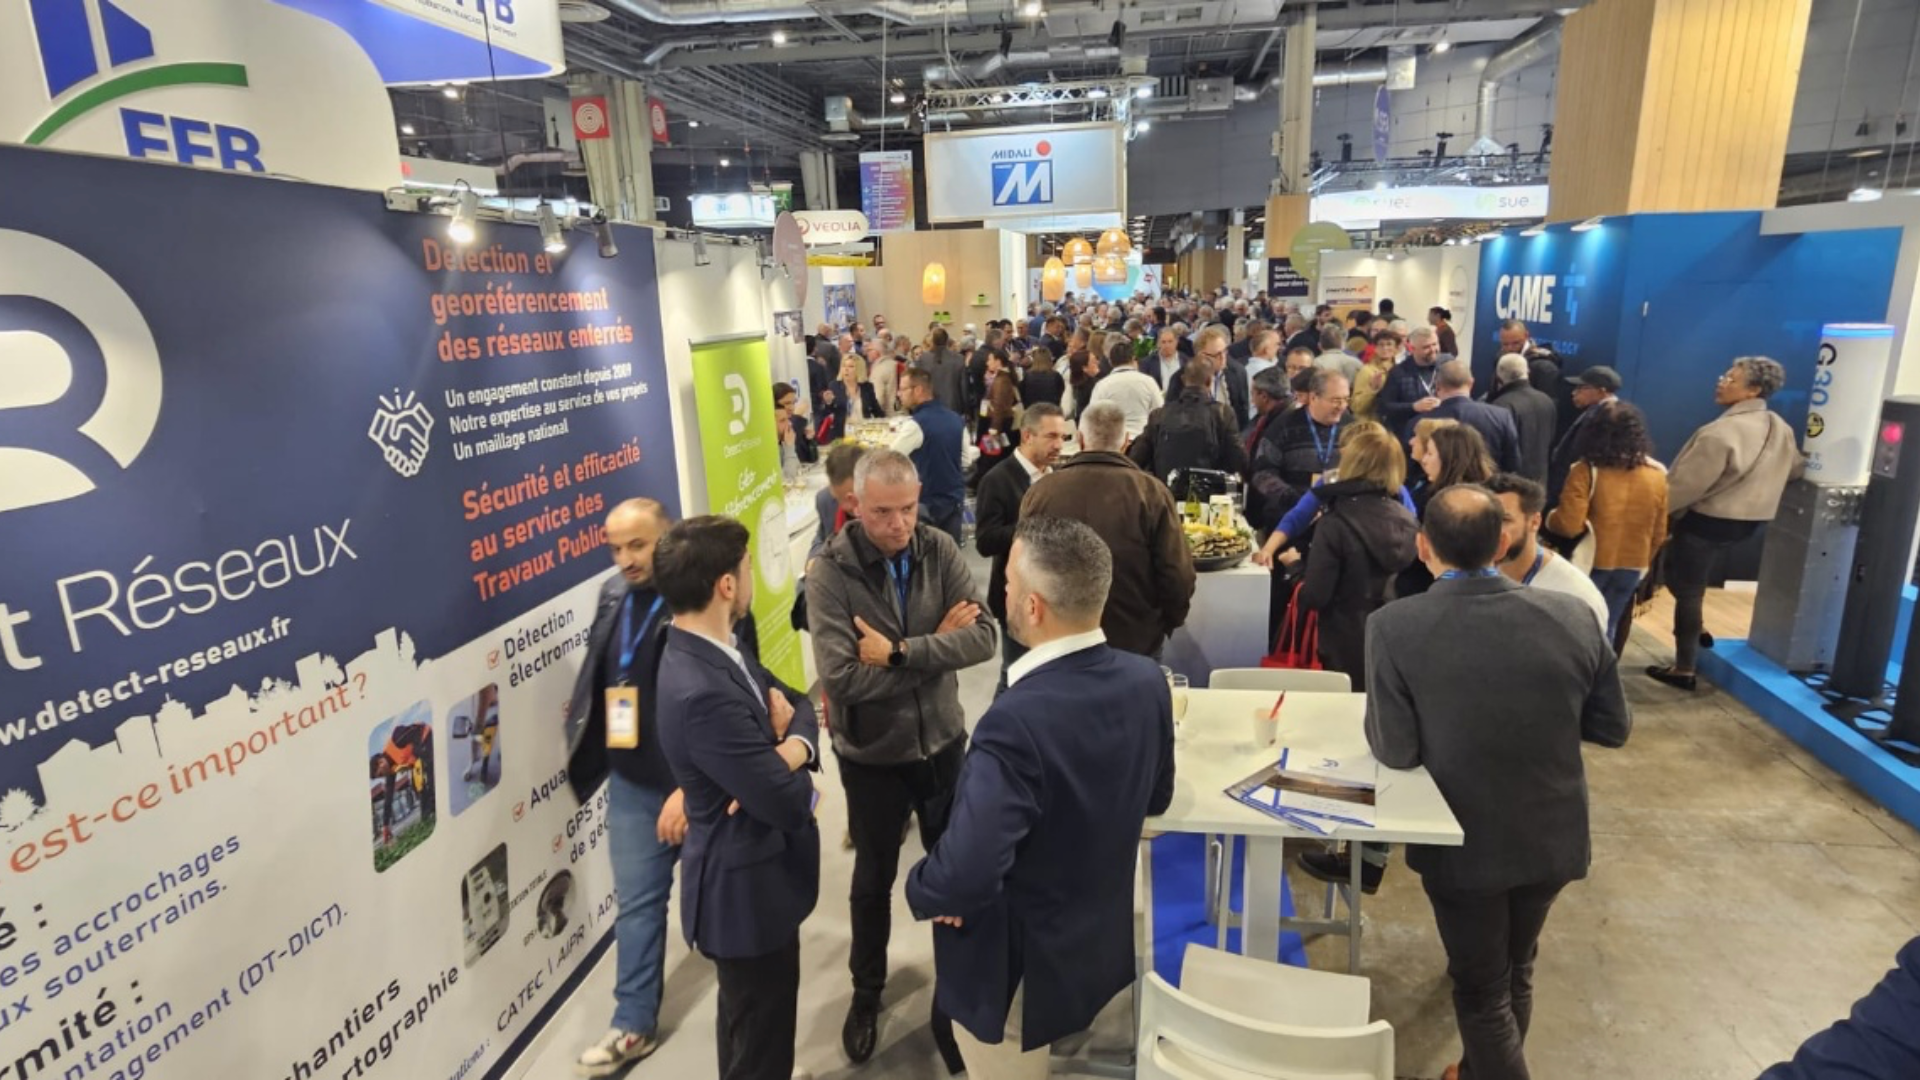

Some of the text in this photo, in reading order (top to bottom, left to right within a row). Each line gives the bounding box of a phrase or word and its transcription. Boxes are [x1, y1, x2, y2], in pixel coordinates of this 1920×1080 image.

[991, 148, 1032, 159] MIDALI
[812, 221, 861, 232] VEOLIA
[1498, 194, 1541, 208] sue
[1495, 274, 1556, 324] CAME
[438, 317, 633, 362] des réseaux enterrés
[445, 362, 632, 408] Un engagement constant depuis 2009
[1811, 342, 1837, 406] G30
[449, 382, 648, 435] Notre expertise au service de vos projets
[453, 418, 569, 460] Un maillage national
[463, 436, 641, 520] Sécurité et efficacité
[471, 493, 604, 562] au service des
[57, 518, 358, 653] Réseaux
[473, 549, 556, 602] Travaux
[504, 608, 575, 660] Détection
[9, 672, 368, 874] est-ce important ?
[566, 801, 593, 839] GPS
[570, 843, 586, 864] de
[54, 834, 241, 956] accrochages
[44, 877, 228, 1000] souterrains.
[237, 903, 348, 996] (DT-DICT).
[497, 969, 545, 1032] CATEC
[557, 924, 585, 968] AIPR
